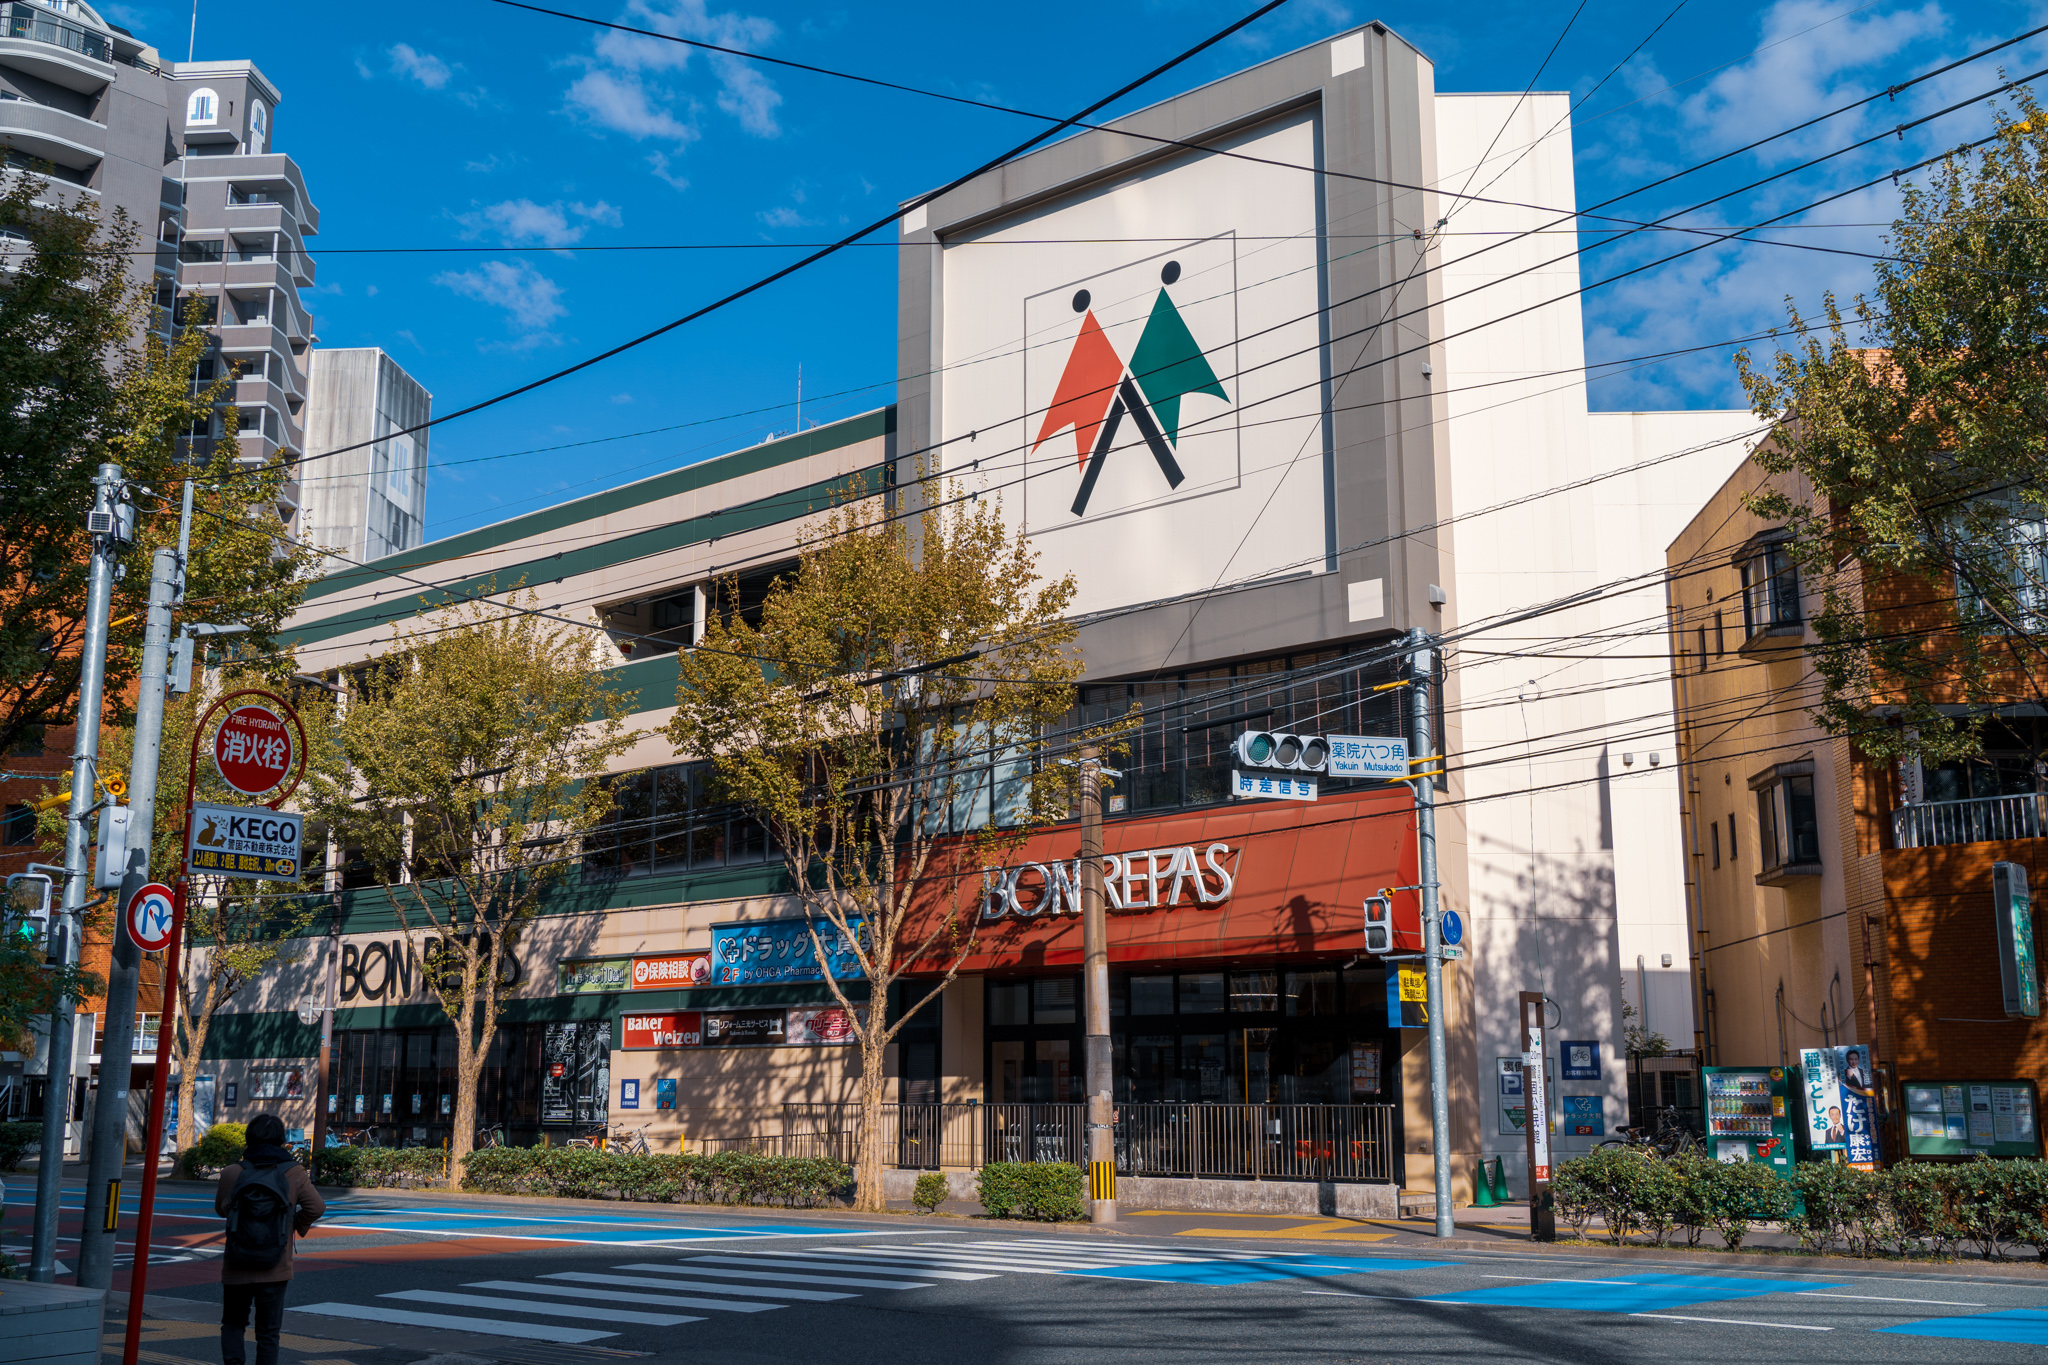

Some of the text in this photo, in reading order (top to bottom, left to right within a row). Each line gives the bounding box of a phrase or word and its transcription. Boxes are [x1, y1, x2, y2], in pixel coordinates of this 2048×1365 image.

[231, 715, 281, 731] FIRE HYDRANT
[222, 729, 287, 770] 消火栓
[1331, 741, 1405, 761] 薬院六つ角
[1334, 761, 1403, 772] Yakuin Mutsukado
[1239, 775, 1311, 796] 時差信号
[229, 816, 296, 844] KEGO
[228, 839, 295, 857] 警固不動産株式会社
[983, 843, 1234, 919] BON REPAS
[340, 940, 414, 1001] BON
[637, 967, 646, 977] 2F
[648, 960, 689, 980] 保険相談
[722, 964, 825, 982] 2F by OHGA Pharmacy
[627, 1017, 664, 1031] Baker
[653, 1030, 700, 1046] Weizen
[1503, 1076, 1519, 1093] P
[1804, 1051, 1828, 1131] 稲員としお
[1579, 1126, 1590, 1134] 2F
[1844, 1094, 1868, 1162] たけ康宏
